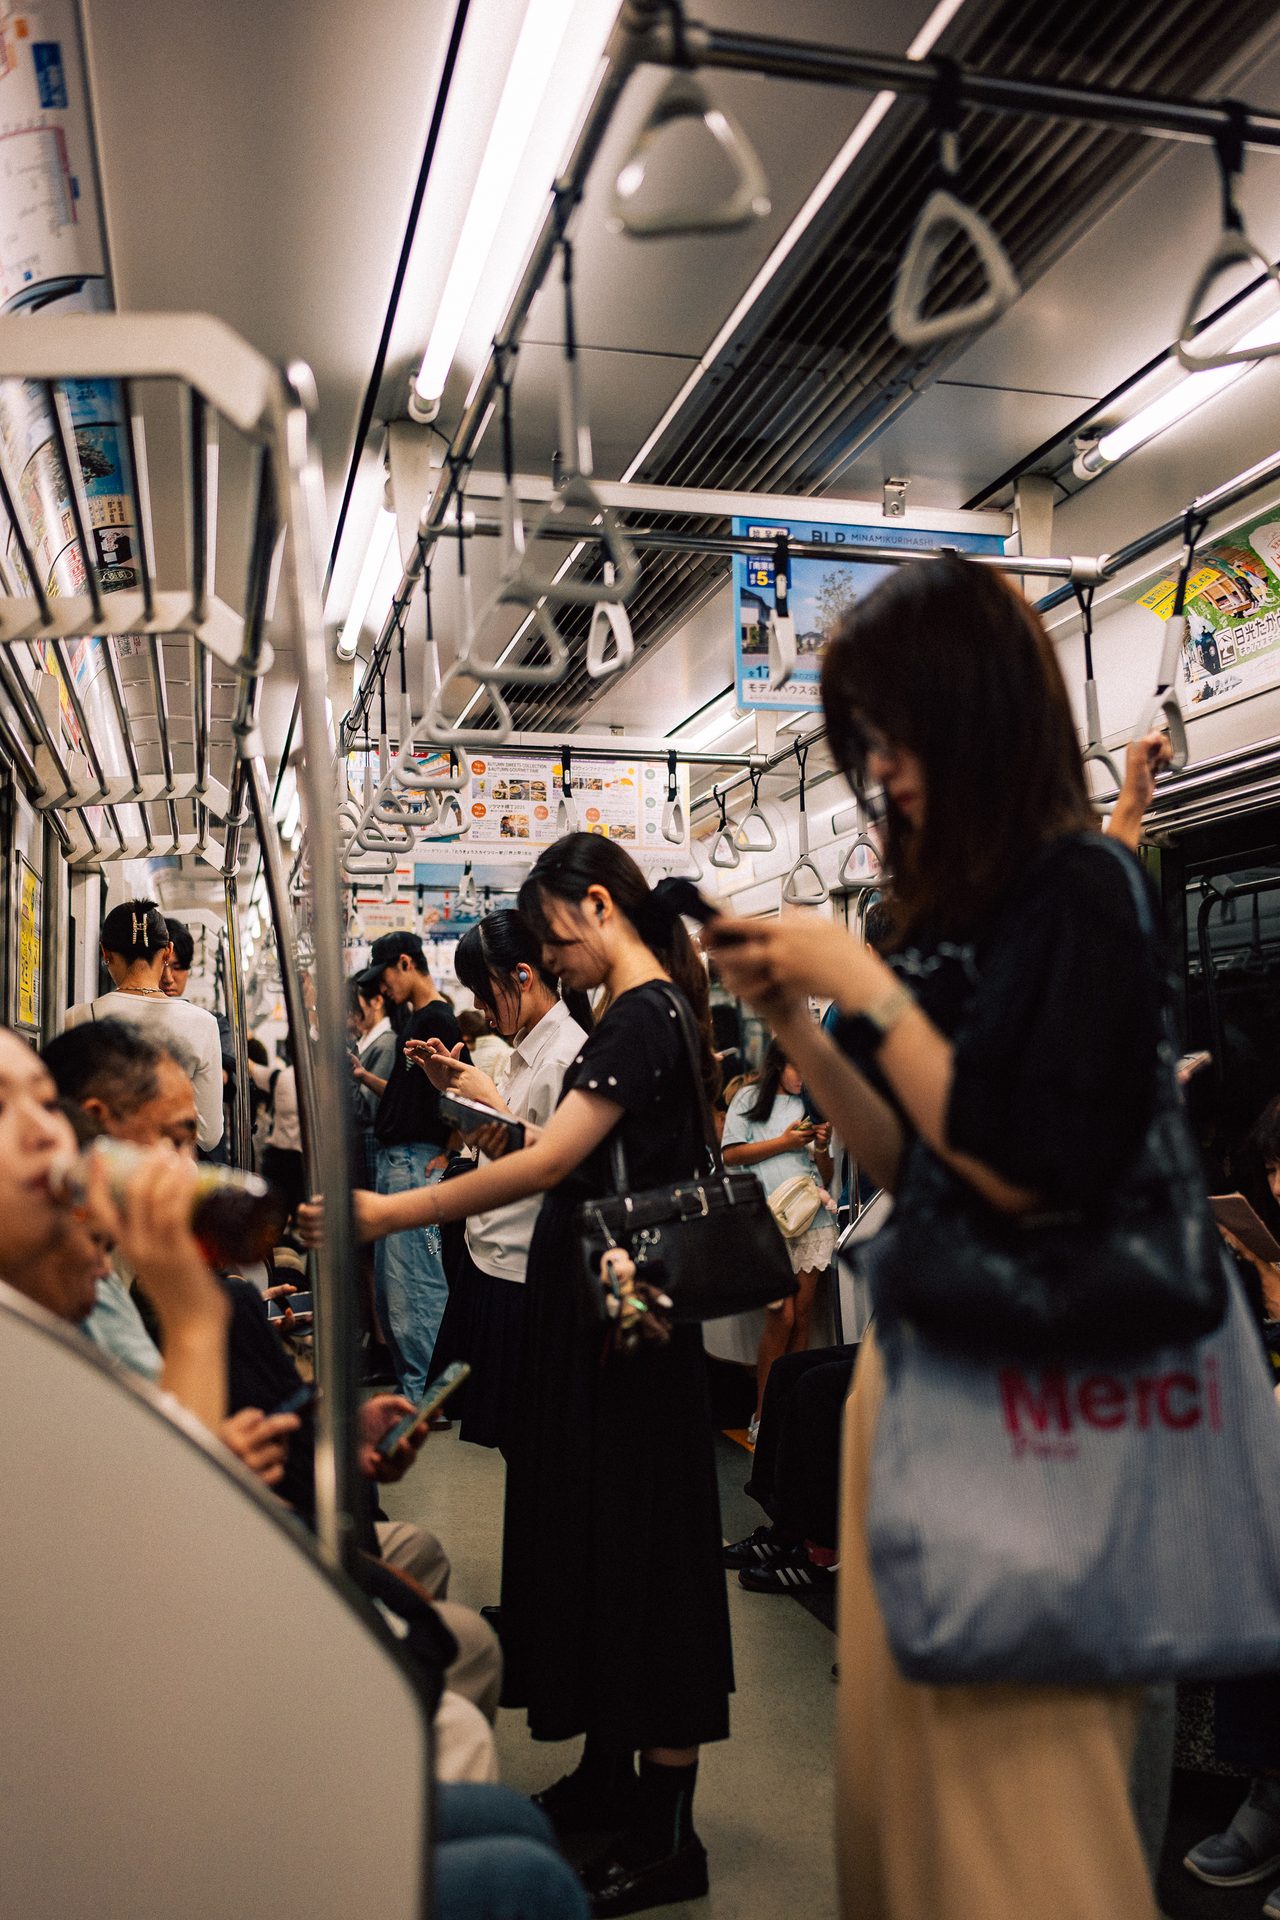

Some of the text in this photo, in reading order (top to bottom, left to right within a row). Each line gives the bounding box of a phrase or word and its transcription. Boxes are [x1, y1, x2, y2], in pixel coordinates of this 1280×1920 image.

[1234, 609, 1280, 646] 日光たか
[1000, 1355, 1222, 1436] Merci
